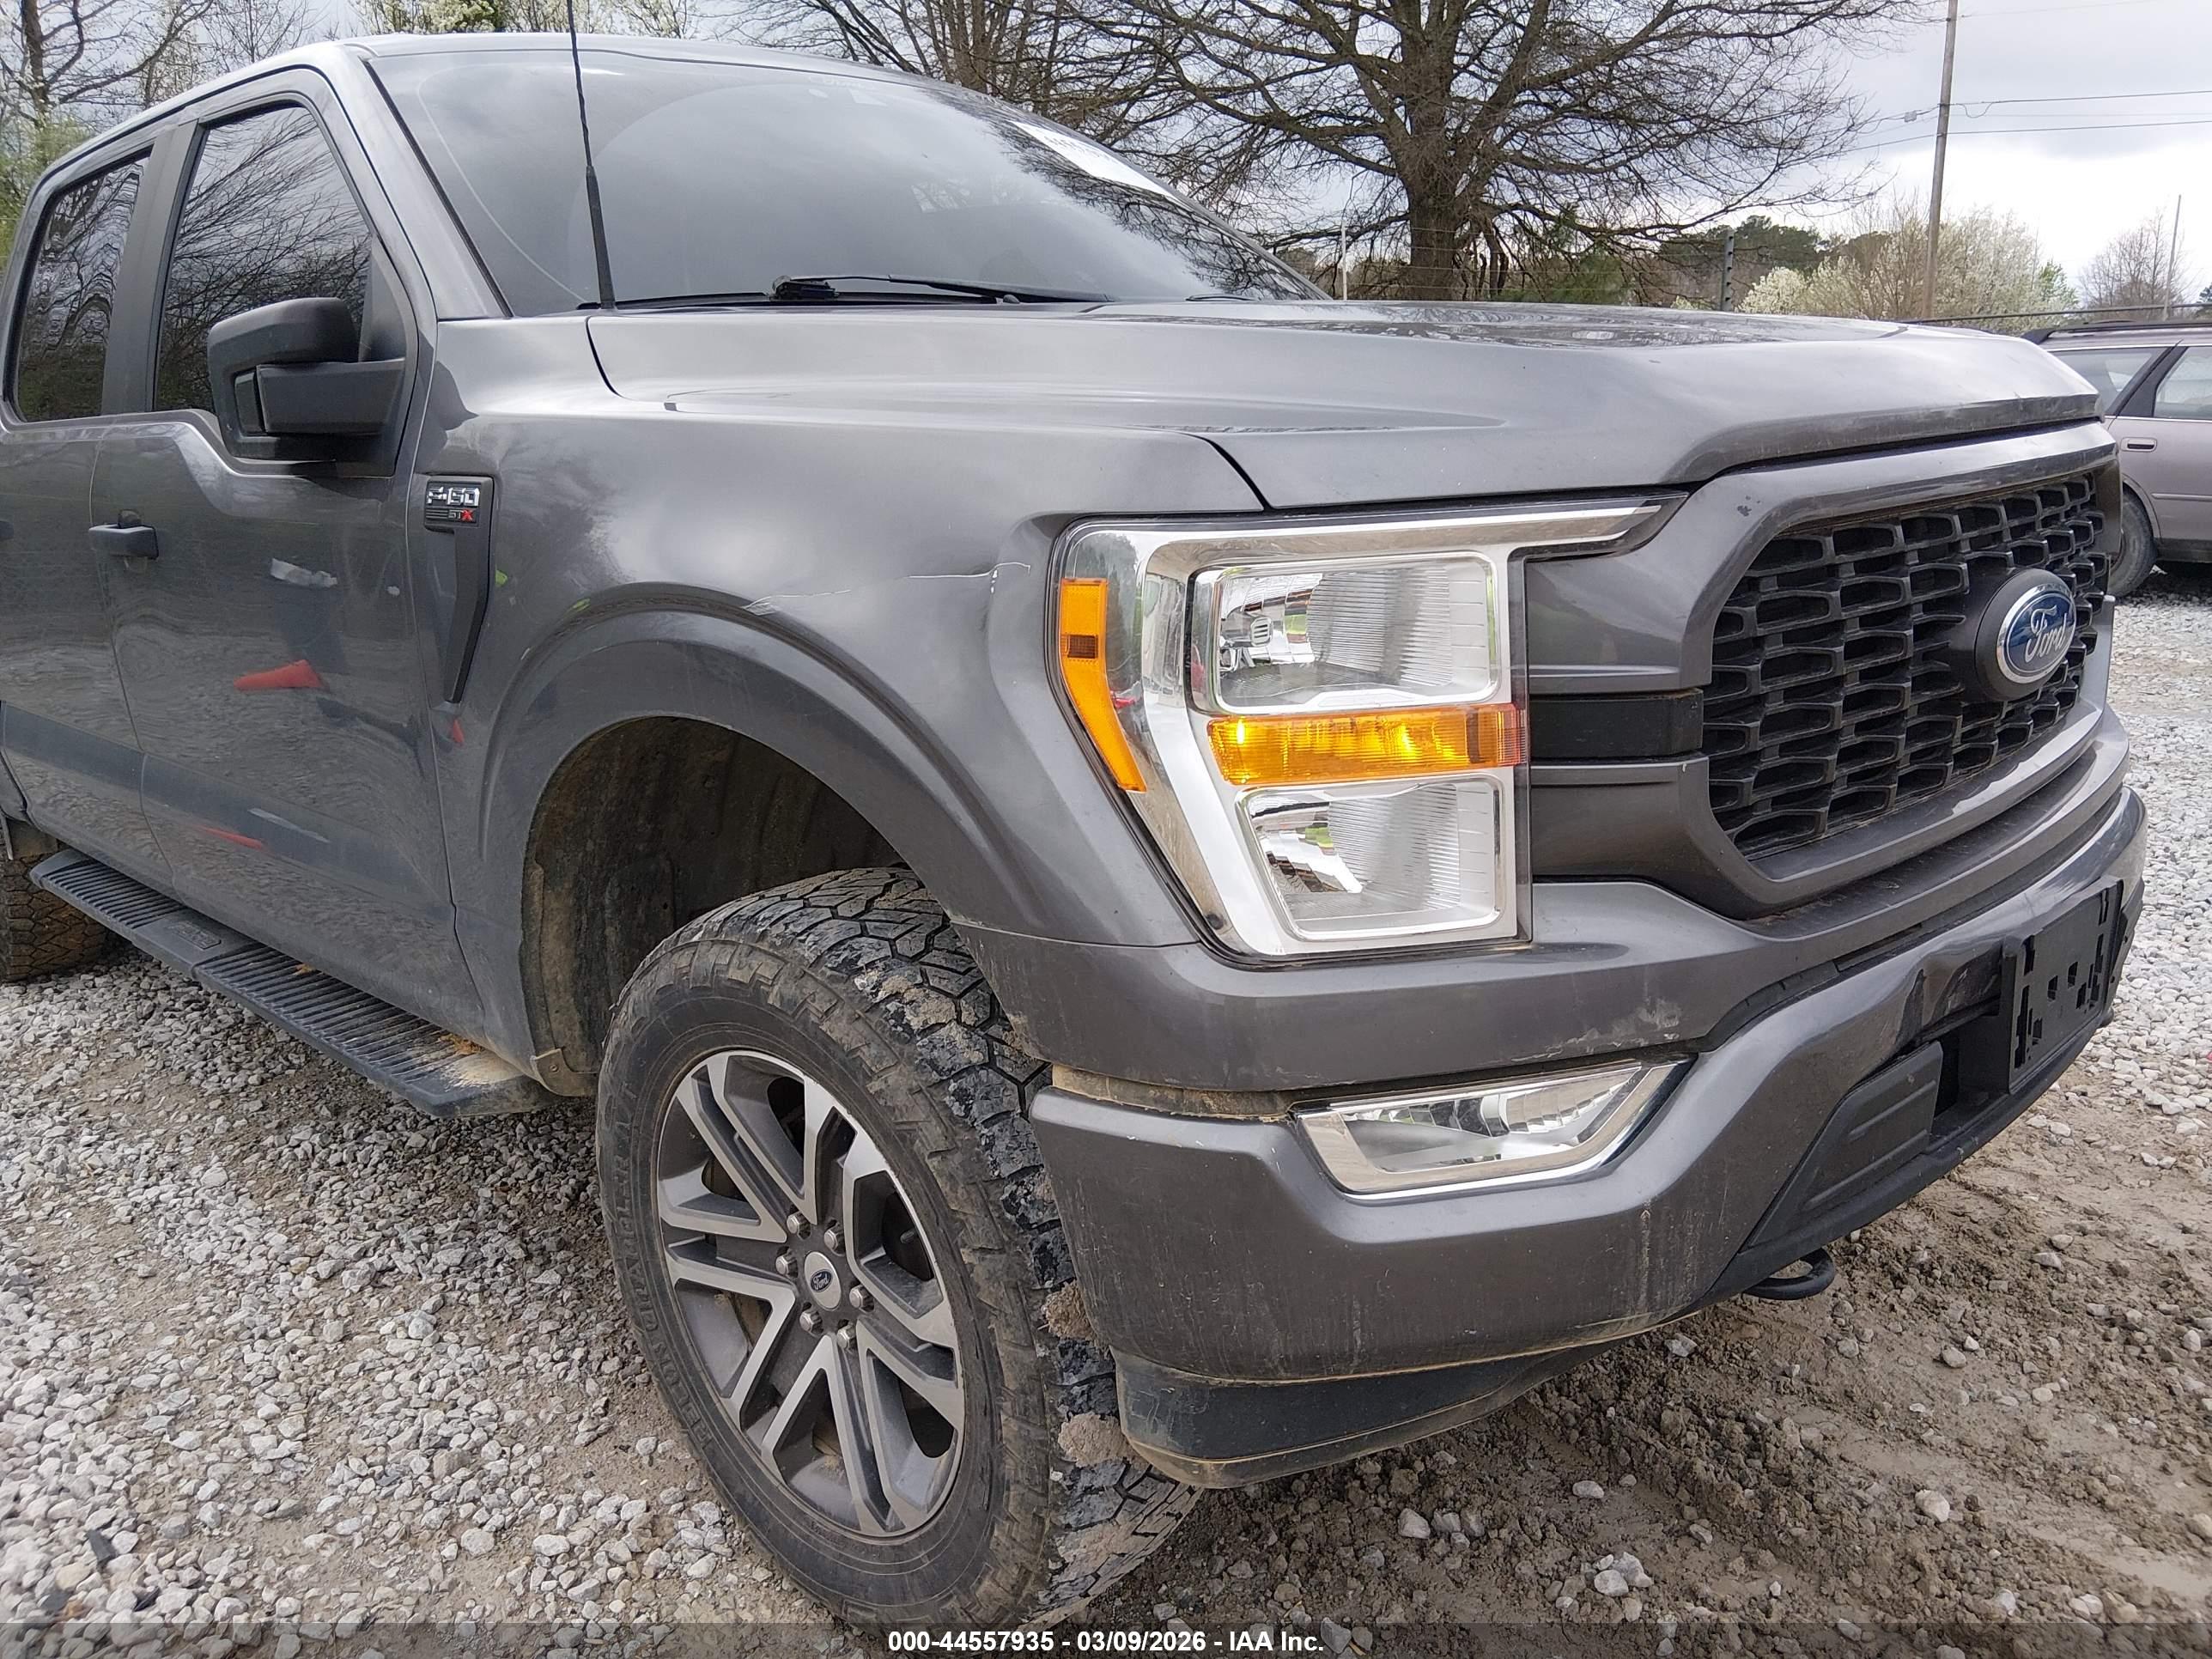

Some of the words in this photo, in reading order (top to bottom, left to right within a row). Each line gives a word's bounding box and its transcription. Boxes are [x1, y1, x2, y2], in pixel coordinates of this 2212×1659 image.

[428, 487, 480, 507] F-150
[449, 509, 473, 521] STX
[2025, 605, 2068, 663] Ford
[813, 1273, 830, 1290] Ford
